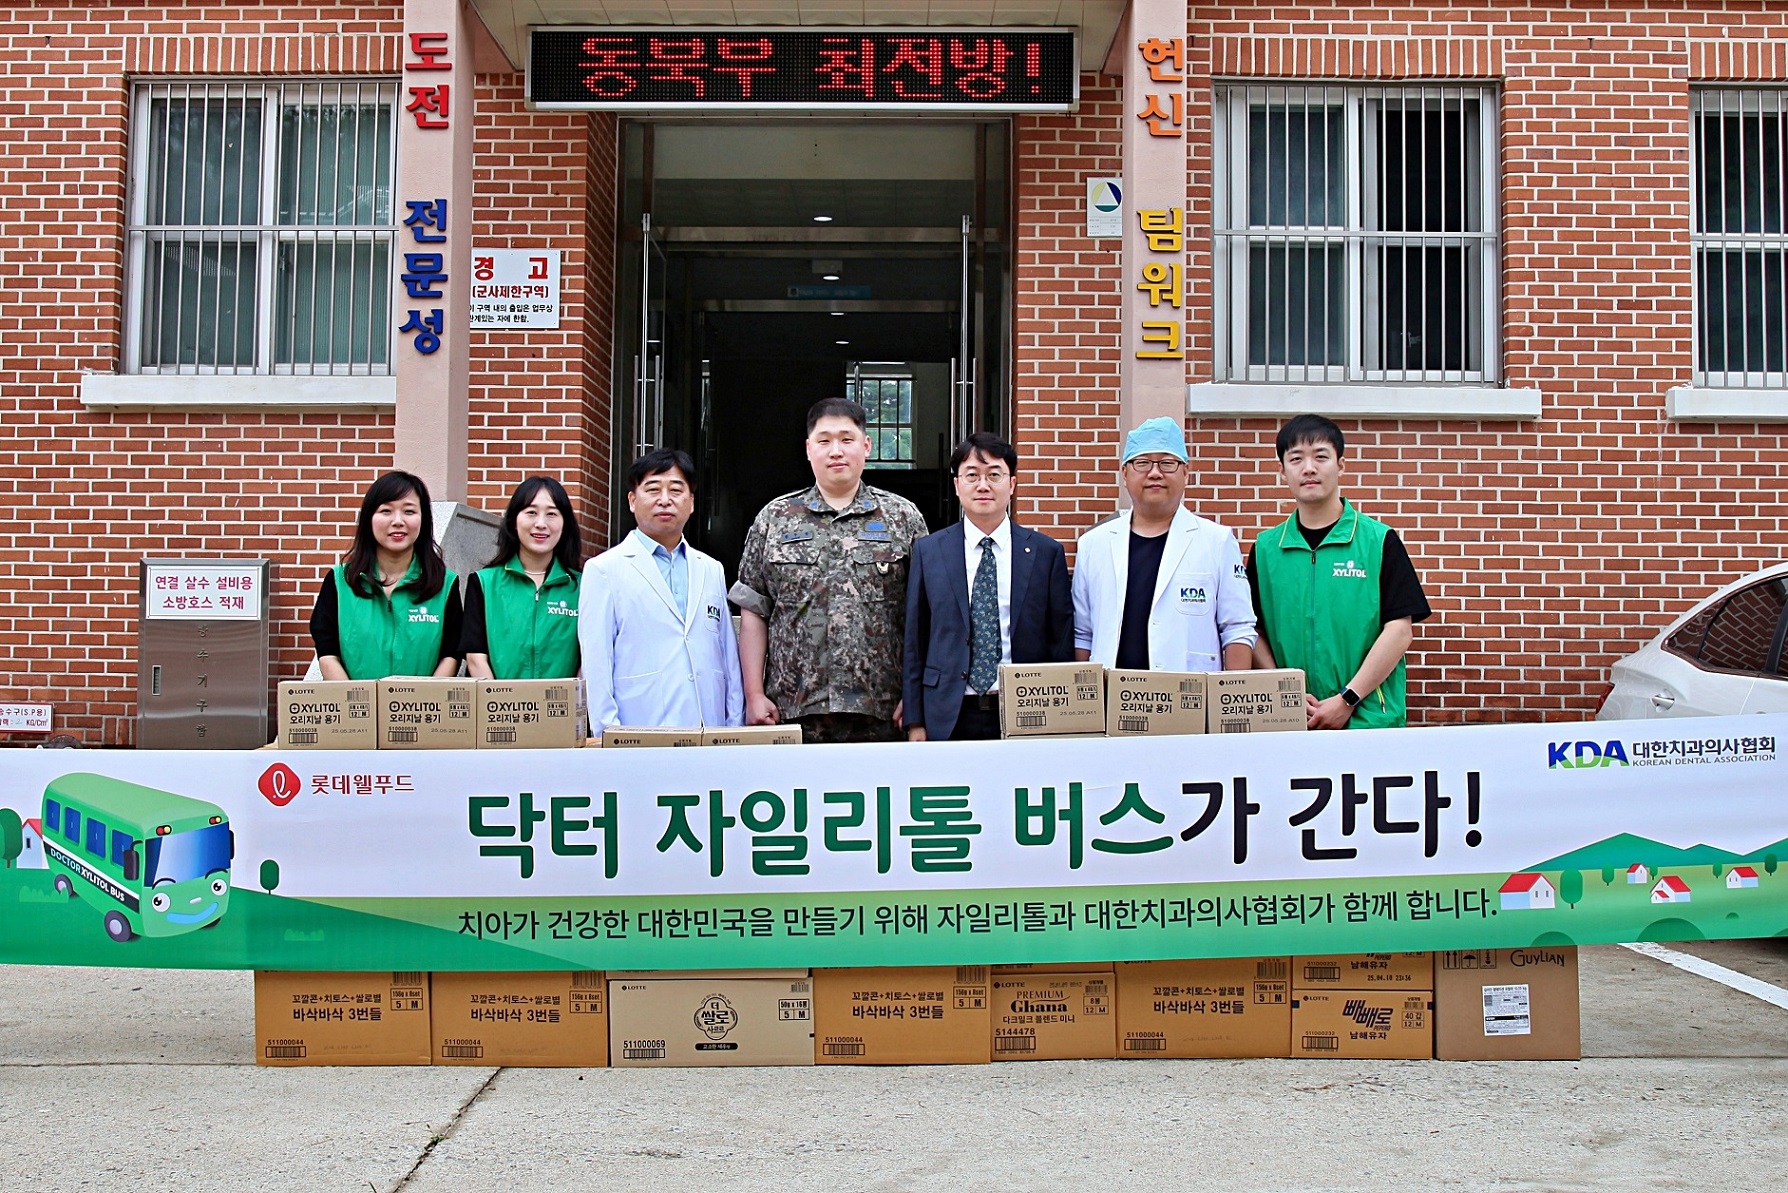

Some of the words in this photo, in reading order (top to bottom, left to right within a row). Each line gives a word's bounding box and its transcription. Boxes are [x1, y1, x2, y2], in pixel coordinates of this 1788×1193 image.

[578, 38, 777, 97] 동북부
[814, 39, 1041, 98] 최전방!
[405, 32, 452, 130] 도전
[1137, 37, 1183, 137] 헌신
[398, 198, 448, 355] 전문성
[1135, 207, 1184, 359] 팀워크
[472, 285, 549, 298] (군사제한구역)
[476, 304, 491, 313] 구역
[493, 304, 507, 313] 내의
[509, 303, 530, 313] 출입은
[532, 304, 553, 313] 업무상
[496, 314, 511, 323] 자에
[513, 314, 530, 323] 한함.
[1332, 567, 1367, 578] XYLITOL
[155, 575, 179, 590] 연결
[184, 575, 210, 590] 살수
[215, 575, 253, 591] 설비용
[1180, 587, 1206, 598] KDA
[162, 596, 213, 610] 소방호스
[218, 595, 245, 610] 적재
[547, 606, 579, 617] XYLITOL
[408, 614, 440, 623] XYLITOL
[1028, 686, 1069, 696] XYLITOL
[1132, 691, 1173, 702] XYLITOL
[1017, 697, 1049, 708] 오리지날
[1053, 697, 1069, 707] 용기
[1232, 693, 1272, 704] XYLITOL
[301, 702, 341, 713] XYLITOL
[402, 702, 441, 712] XYLITOL
[499, 702, 539, 712] XYLITOL
[1120, 702, 1153, 713] 오리지날
[1156, 703, 1172, 713] 용기
[1221, 705, 1254, 715] 오리지날
[1257, 704, 1273, 715] 용기
[290, 715, 322, 725] 오리지날
[324, 715, 341, 724] 용기
[390, 714, 422, 724] 오리지날
[425, 714, 441, 724] 용기
[488, 714, 520, 723] 오리지날
[522, 714, 539, 723] 용기
[1632, 736, 1777, 759] 대한치과의사협회
[1548, 739, 1630, 769] KDA
[1632, 757, 1672, 767] KOREAN
[1675, 757, 1712, 766] DENTAL
[1714, 754, 1777, 764] ASSOCIATION
[310, 773, 416, 797] 롯데웰푸드
[467, 791, 620, 879] 닥터
[655, 786, 983, 878] 자일리톨
[1014, 776, 1261, 870] 버스가
[1288, 770, 1483, 861] 간다!
[50, 847, 81, 874] DOCTOR
[80, 866, 110, 893] XYLITOL
[110, 886, 126, 902] BUS
[457, 909, 541, 940] 치아가
[547, 909, 630, 940] 건강한
[637, 907, 776, 939] 대한민국을
[783, 905, 866, 936] 만들기
[873, 903, 929, 935] 위해
[936, 900, 1077, 934] 자일리톨과
[1085, 893, 1336, 931] 대한치과의사협회가
[1342, 892, 1399, 922] 함께
[1405, 888, 1498, 921] 합니다.
[1350, 961, 1388, 970] 남해유자
[1016, 990, 1064, 999] PREMIUM
[1153, 986, 1245, 996] 꼬깔콘+치토스+쌀로별
[292, 994, 382, 1004] 꼬깔콘+치토스+쌀로별
[470, 994, 561, 1005] 꼬깔콘+치토스+쌀로별
[852, 992, 944, 1002] 꼬깔콘+치토스+쌀로별
[1259, 994, 1265, 1002] 5
[1274, 994, 1282, 1002] M
[710, 1001, 720, 1010] 더
[958, 999, 964, 1007] 5
[974, 999, 982, 1007] M
[1010, 1000, 1068, 1013] Ghana
[1153, 1000, 1206, 1014] 바삭바삭
[1210, 1000, 1245, 1014] 3번들
[293, 1007, 344, 1021] 바삭바삭
[348, 1007, 383, 1021] 3번들
[471, 1008, 522, 1022] 바삭바삭
[527, 1008, 561, 1023] 3번들
[701, 1010, 730, 1025] 쌀로
[784, 1010, 790, 1019] 5
[798, 1010, 806, 1018] M
[852, 1005, 905, 1019] 바삭바삭
[909, 1005, 944, 1019] 3번들
[1342, 1000, 1394, 1028] 빼빼로
[1405, 1012, 1414, 1020] 40
[1002, 1015, 1034, 1024] 다크밀크
[1035, 1015, 1058, 1024] 블렌드
[1060, 1014, 1075, 1023] 미니
[995, 1027, 1035, 1036] 5144478
[1350, 1031, 1387, 1040] 남해유자
[623, 1040, 666, 1049] 511000069
